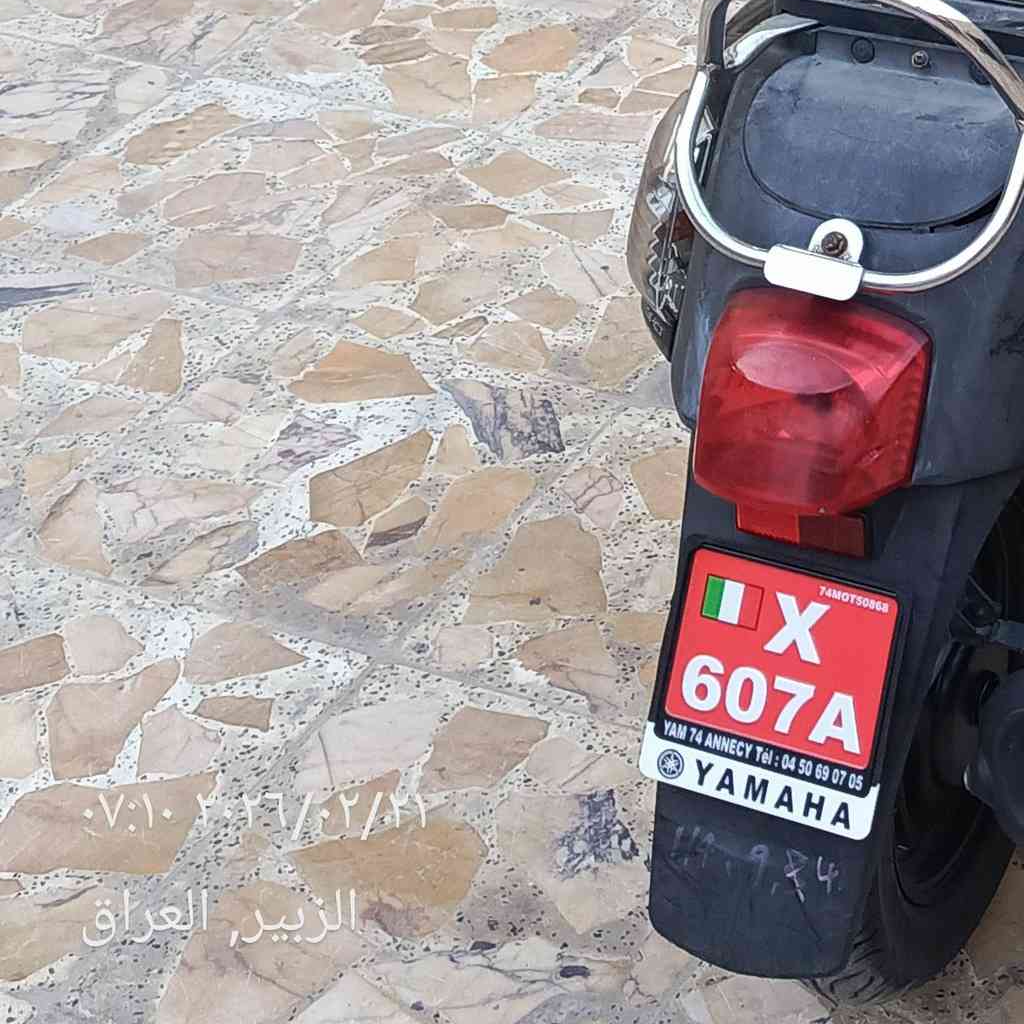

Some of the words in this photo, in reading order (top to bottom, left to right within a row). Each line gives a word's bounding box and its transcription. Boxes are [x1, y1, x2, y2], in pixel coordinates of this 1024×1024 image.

[763, 591, 831, 665] X
[682, 654, 861, 754] 607A
[663, 719, 687, 740] YAM
[689, 727, 704, 745] 74
[704, 732, 753, 758] ANNECY
[755, 743, 773, 765] Tél
[781, 754, 796, 772] 04
[798, 758, 813, 776] 50
[815, 763, 830, 781] 69
[831, 768, 847, 786] 07
[848, 773, 864, 791] 05
[695, 758, 851, 829] YAMAHA
